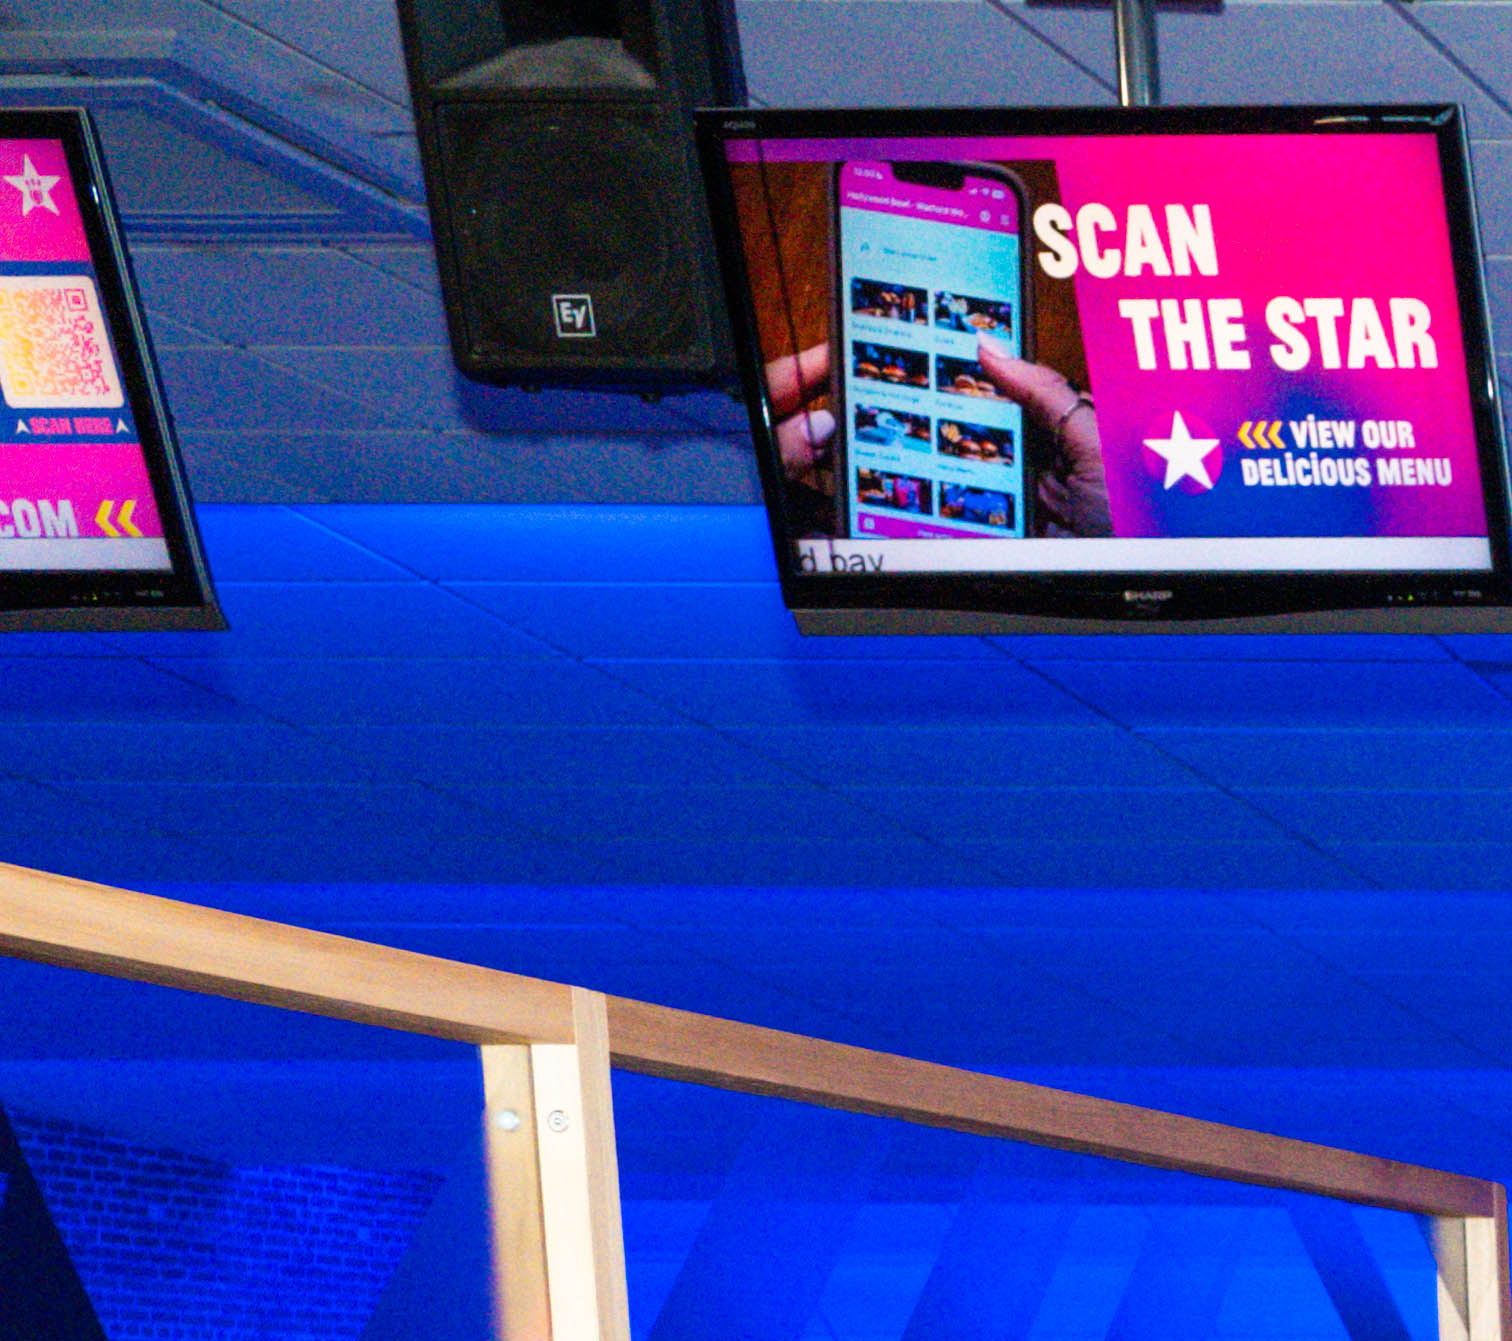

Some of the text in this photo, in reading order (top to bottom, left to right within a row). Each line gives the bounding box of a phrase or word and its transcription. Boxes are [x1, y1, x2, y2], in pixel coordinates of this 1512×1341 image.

[1033, 201, 1219, 279] SCAN
[1119, 296, 1439, 372] THE STAR
[29, 417, 73, 436] SCAN
[1363, 420, 1416, 449] OUR
[1376, 457, 1453, 487] MENU
[1123, 589, 1174, 602] SHARP
